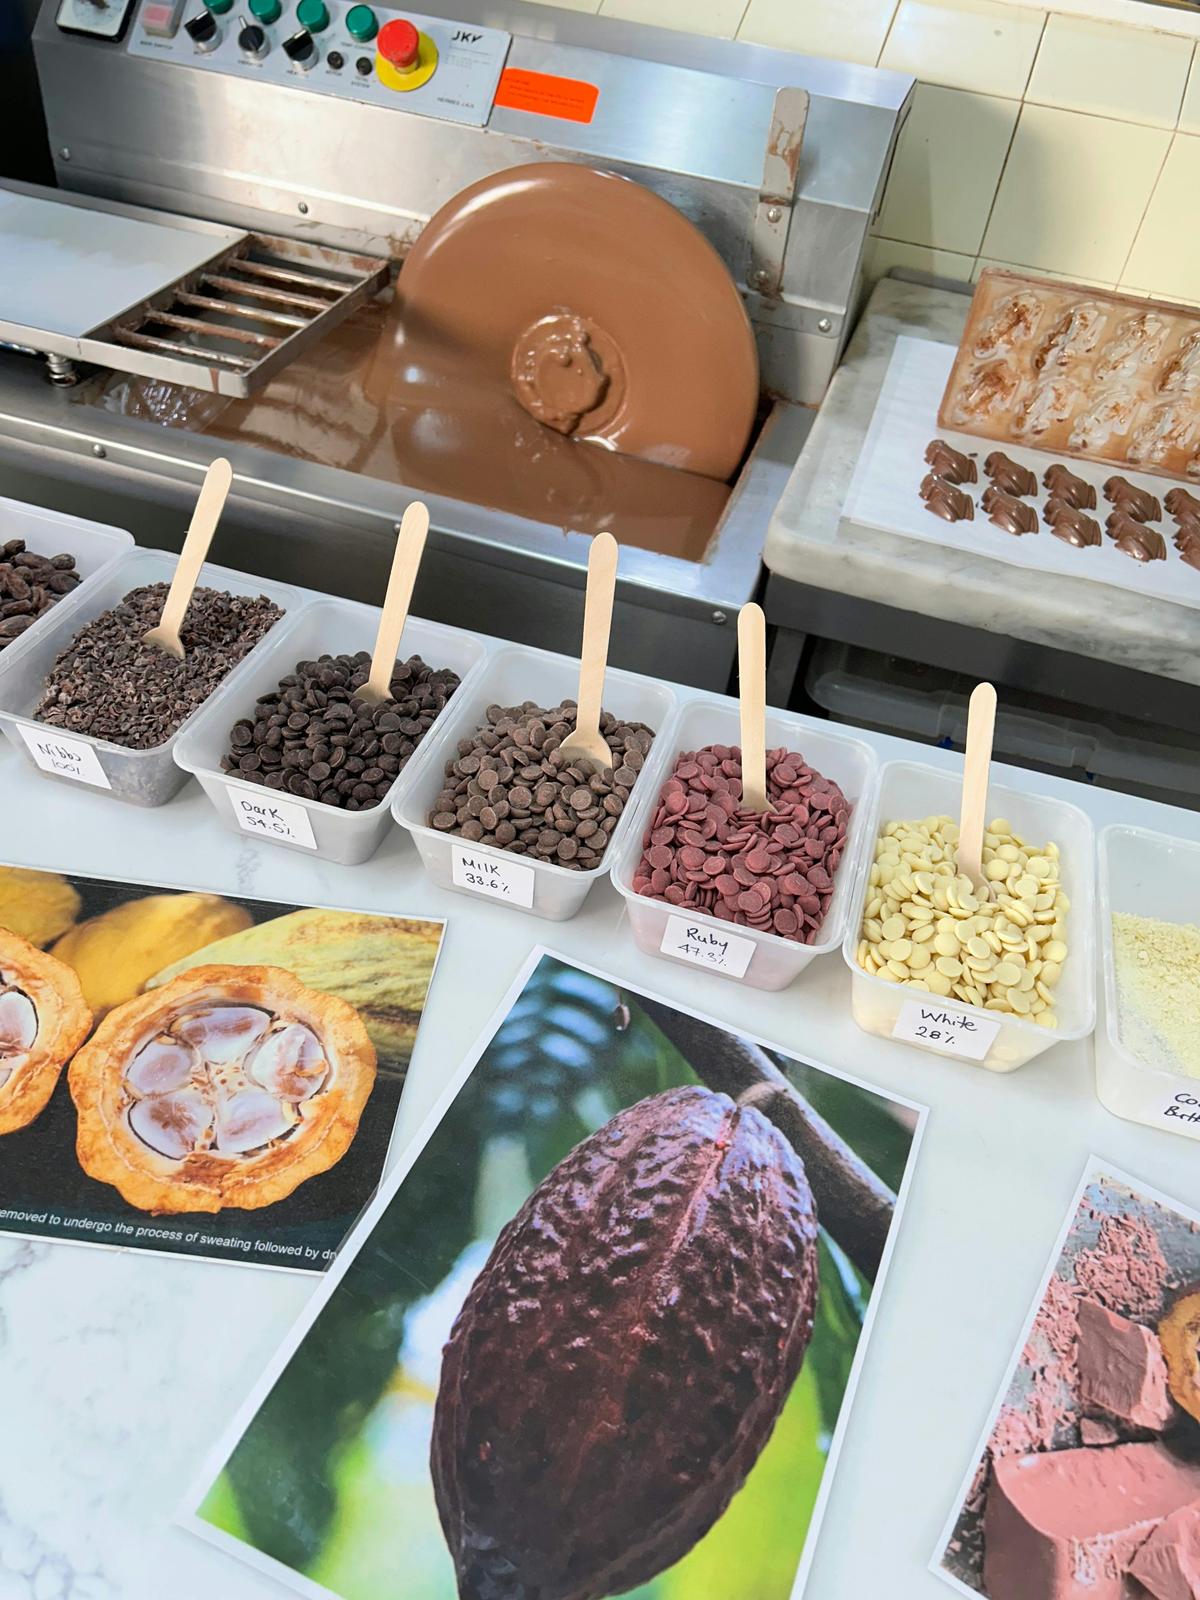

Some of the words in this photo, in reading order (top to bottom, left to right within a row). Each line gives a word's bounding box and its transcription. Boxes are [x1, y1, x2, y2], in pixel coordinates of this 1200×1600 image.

[465, 872, 510, 894] 33.6%
[686, 927, 729, 955] Ruby
[677, 943, 727, 967] 47.3%
[921, 1008, 978, 1032] White
[915, 1025, 955, 1045] 28%
[1174, 1092, 1200, 1108] Co
[0, 1208, 47, 1223] emoved
[48, 1214, 61, 1225] to
[63, 1216, 113, 1232] undergo
[115, 1222, 134, 1234] the
[135, 1225, 182, 1241] process
[185, 1231, 200, 1242] of
[200, 1233, 252, 1252] sweating
[254, 1239, 303, 1257] followed
[304, 1246, 320, 1261] by
